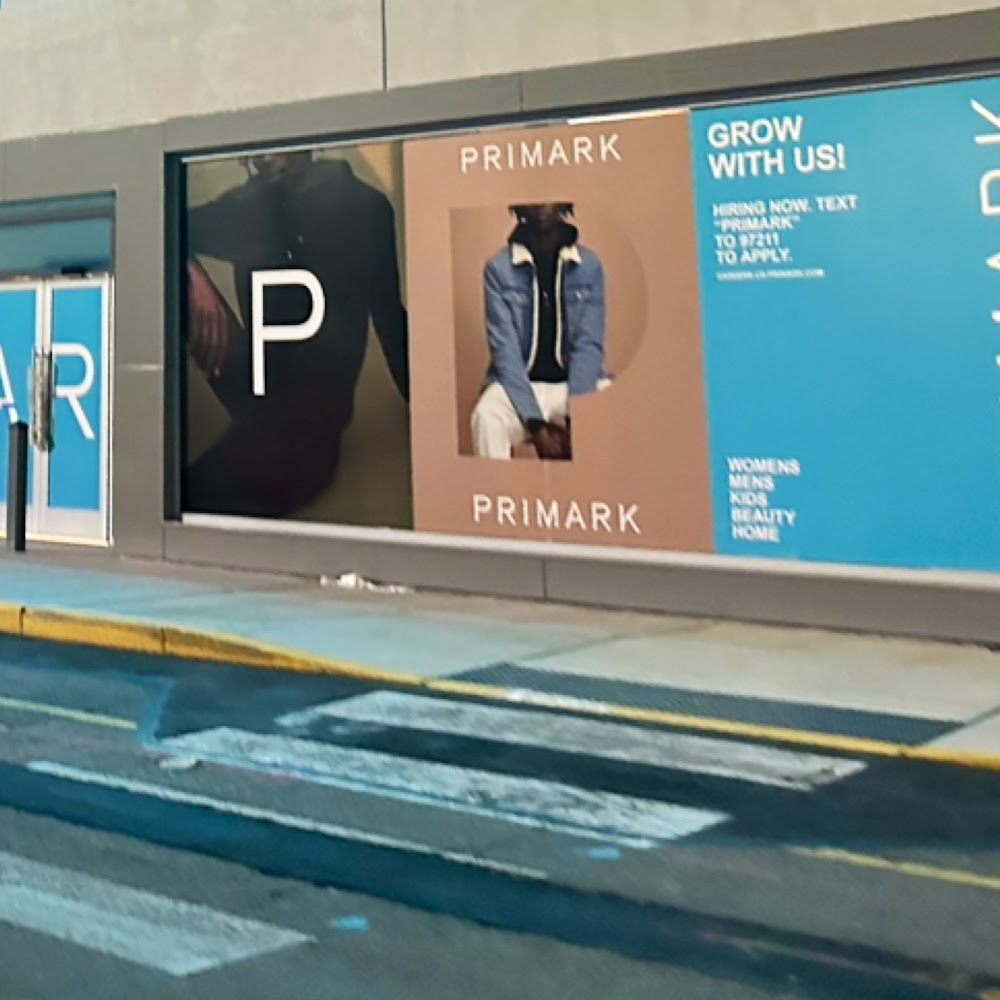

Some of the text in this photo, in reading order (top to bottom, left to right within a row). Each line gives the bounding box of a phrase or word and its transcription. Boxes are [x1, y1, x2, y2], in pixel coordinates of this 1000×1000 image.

[708, 114, 803, 148] GROW
[460, 133, 622, 173] PRIMARK
[707, 142, 846, 179] WITH US!
[712, 200, 766, 217] HIRING
[815, 194, 859, 211] TEXT
[715, 233, 736, 249] TO
[716, 247, 793, 265] TO APPLY.
[251, 267, 326, 397] P
[727, 457, 801, 476] WOMENS
[729, 474, 775, 491] MENS
[729, 491, 768, 507] KIDS
[473, 494, 642, 534] PRIMARK
[731, 508, 796, 527] BEAUTY
[731, 524, 780, 543] HOME
